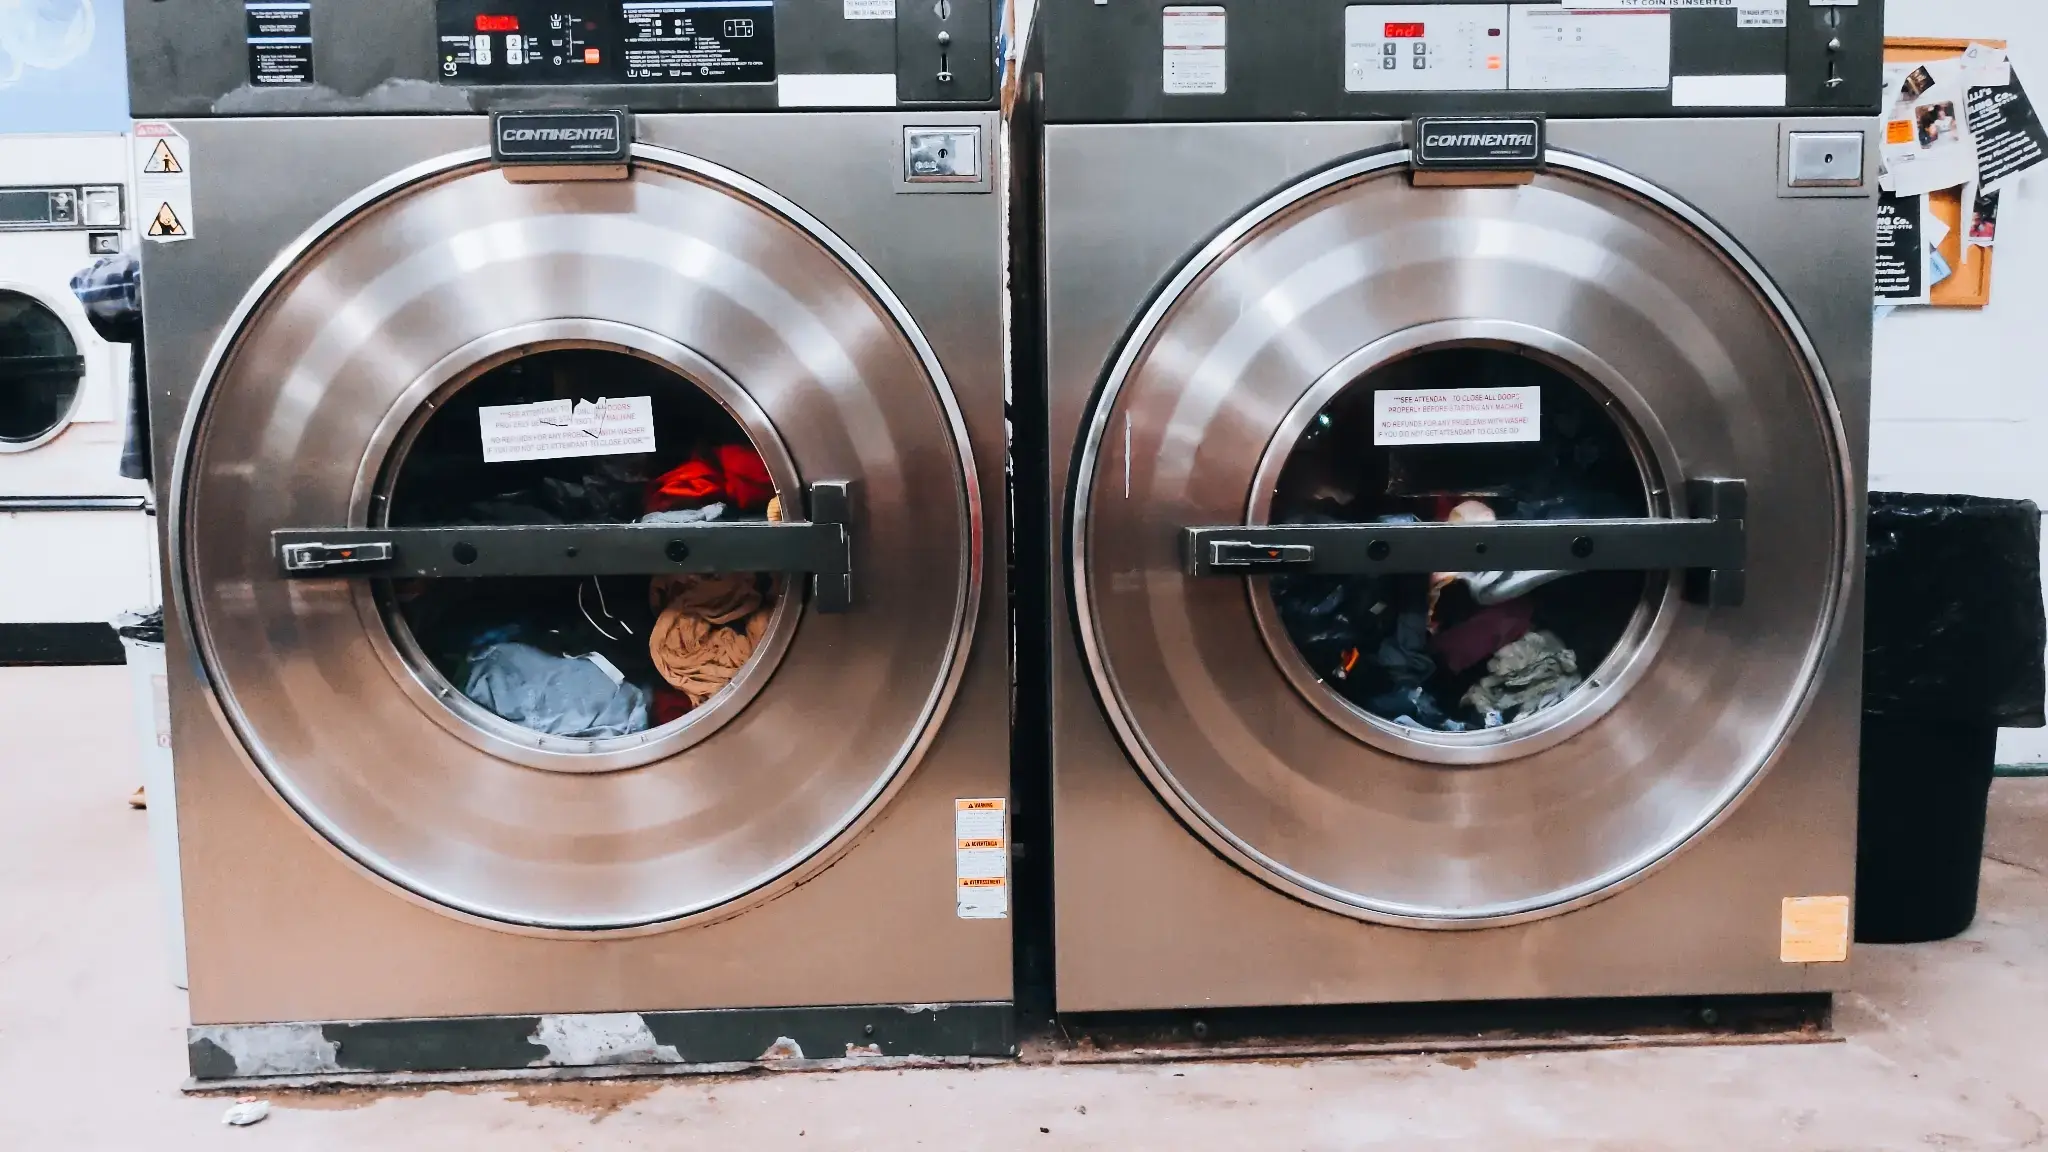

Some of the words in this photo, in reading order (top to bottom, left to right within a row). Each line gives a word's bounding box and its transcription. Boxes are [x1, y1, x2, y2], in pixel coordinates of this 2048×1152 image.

[1385, 24, 1415, 37] End
[1416, 44, 1424, 54] 2
[1387, 58, 1393, 68] 3
[1416, 59, 1424, 68] 4
[503, 128, 615, 141] CONTINENTAL
[1425, 134, 1534, 147] CONTINENTAL
[1893, 216, 1910, 225] Co.
[1415, 395, 1448, 403] ATTENDAN
[1453, 394, 1461, 402] TO
[607, 403, 631, 411] DOORS
[1450, 403, 1480, 411] STARTING
[1482, 403, 1493, 411] ANY
[1496, 402, 1524, 410] MACHINE
[1452, 418, 1487, 426] PROBLEMS
[491, 436, 501, 444] NO
[534, 433, 547, 441] FOR
[548, 432, 561, 440] ANY
[617, 427, 645, 435] WASHER
[1440, 428, 1475, 436] ATTENDANT
[536, 443, 549, 451] GET
[550, 440, 588, 449] ATTENDANT
[590, 439, 600, 447] TO
[600, 438, 621, 446] CLOSE
